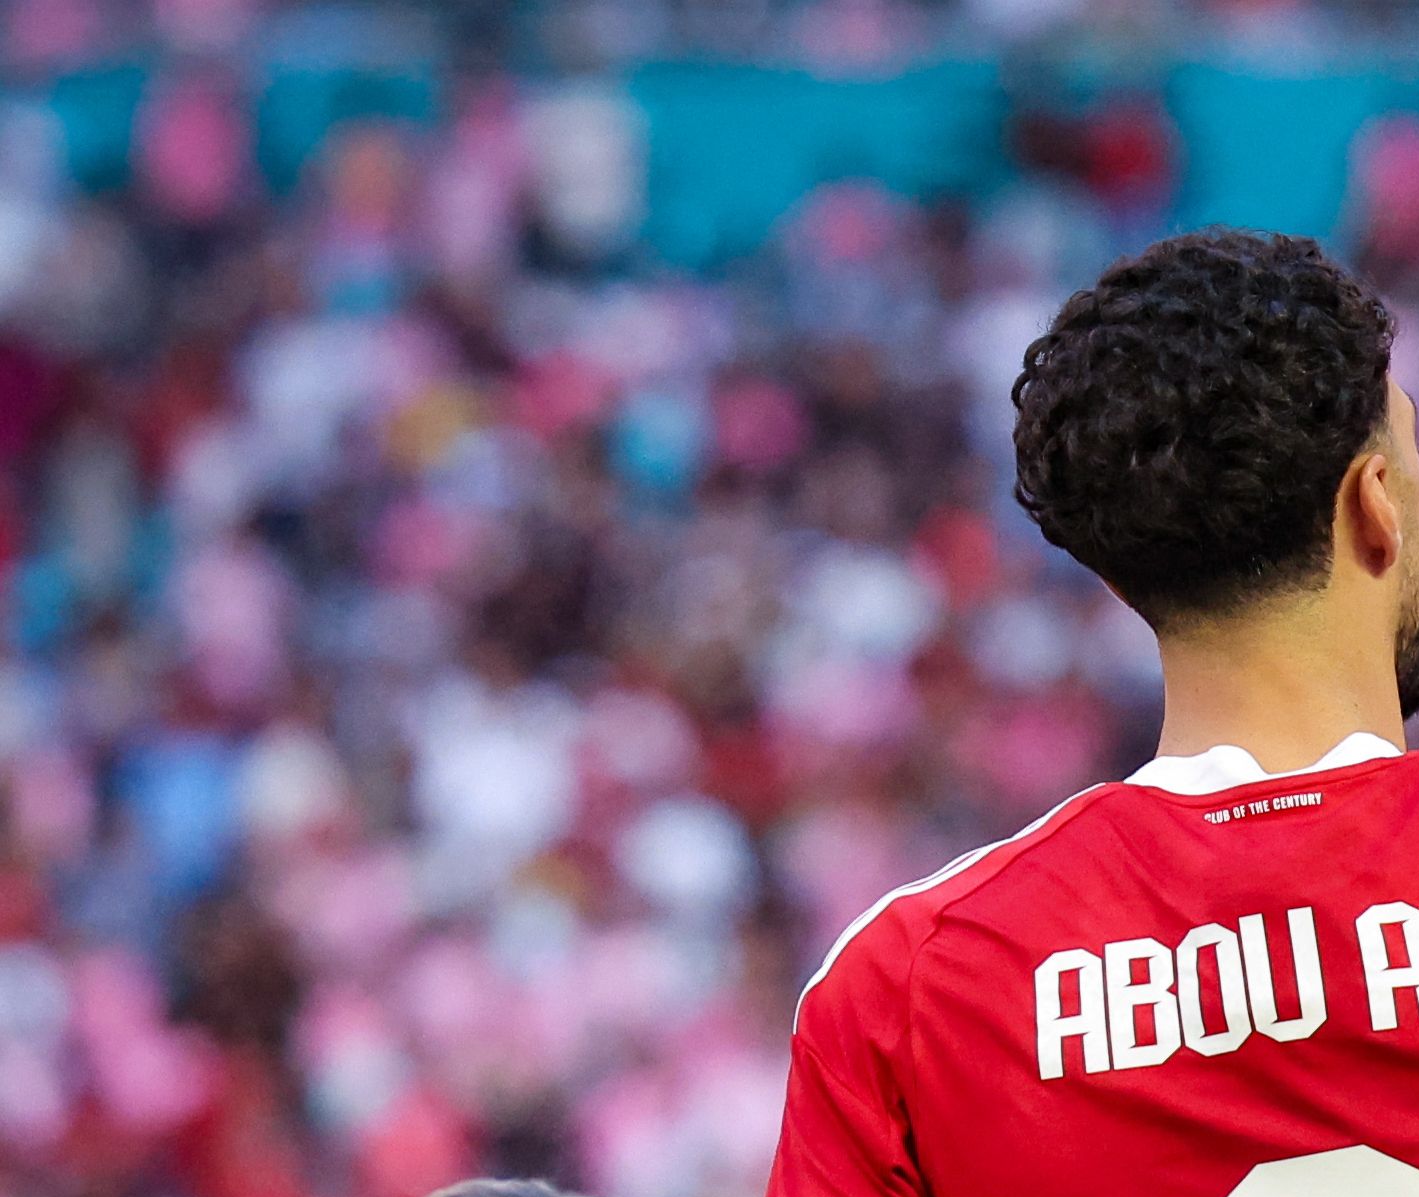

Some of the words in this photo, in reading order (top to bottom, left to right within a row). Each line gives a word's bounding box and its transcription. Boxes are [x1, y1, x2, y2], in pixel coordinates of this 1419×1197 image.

[1233, 804, 1246, 819] OF
[1248, 800, 1270, 813] THE
[1272, 792, 1322, 810] CENTURY
[1034, 906, 1328, 1080] ABOU
